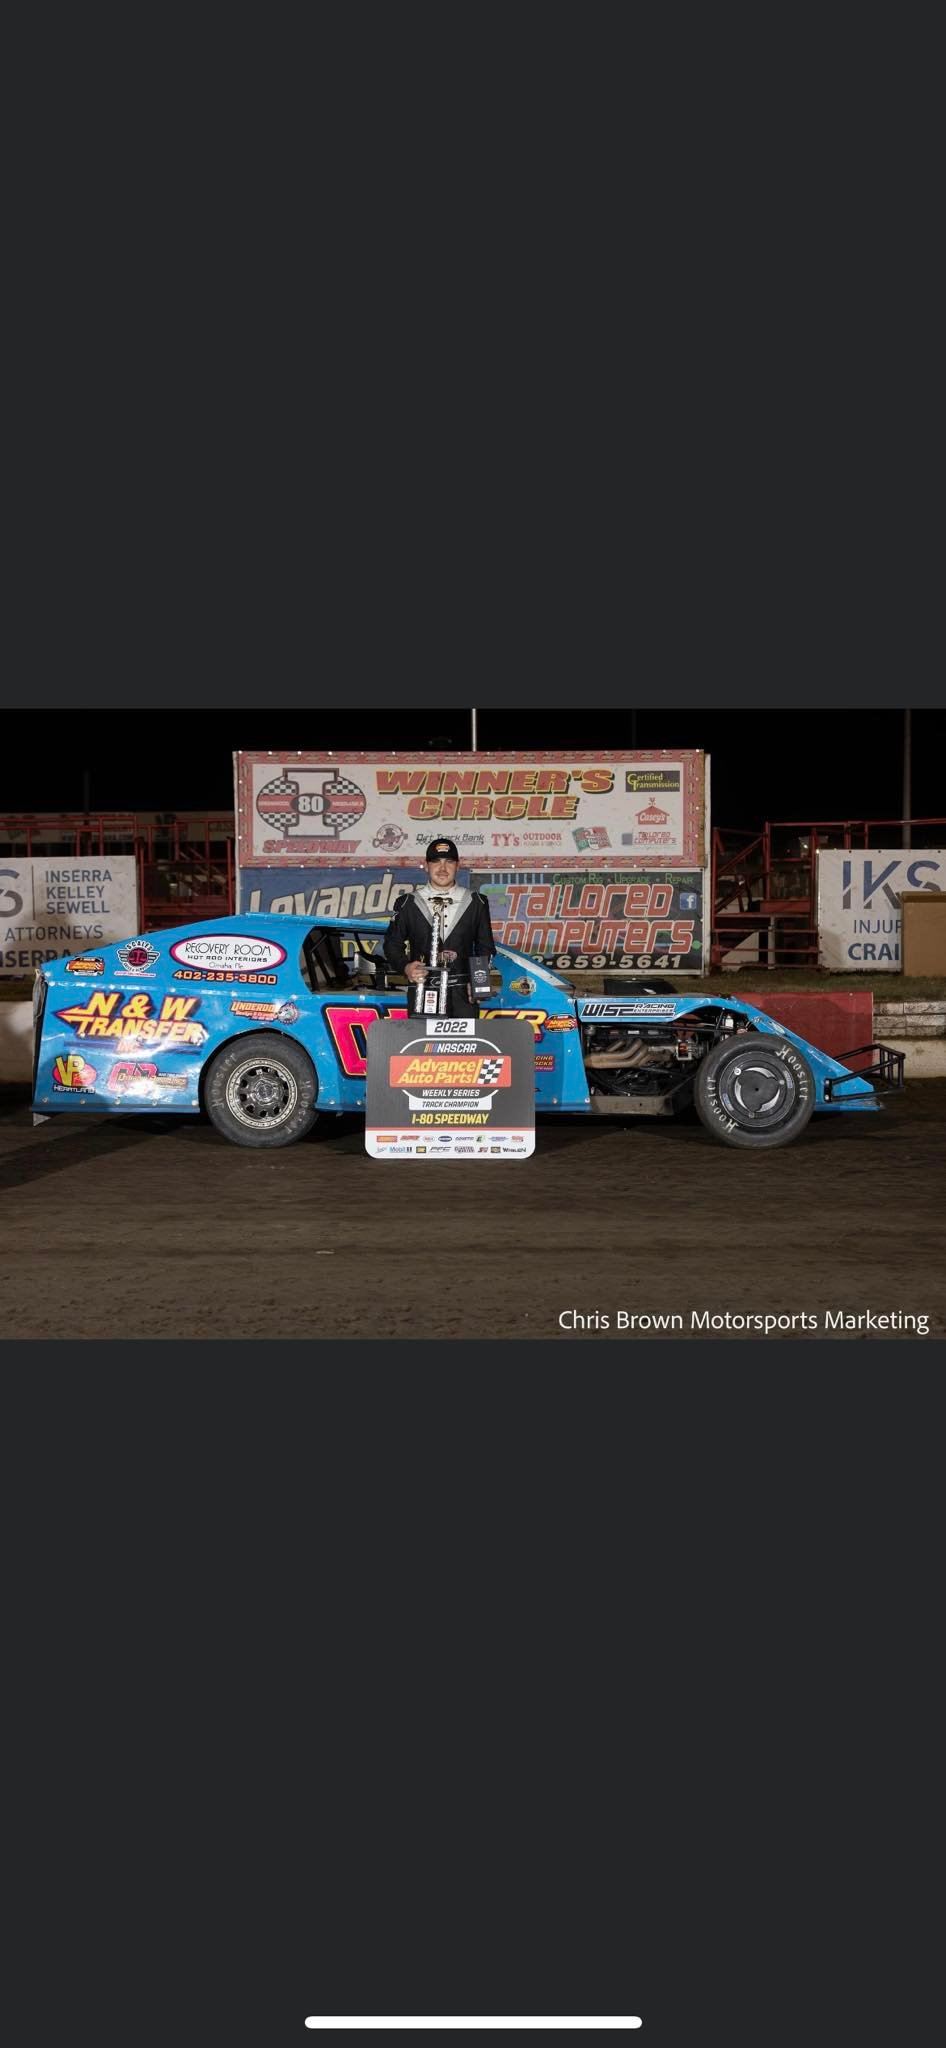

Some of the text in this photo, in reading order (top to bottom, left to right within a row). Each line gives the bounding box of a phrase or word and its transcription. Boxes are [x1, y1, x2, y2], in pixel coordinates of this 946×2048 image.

[376, 770, 615, 794] WINNER'S
[627, 772, 664, 785] Certified
[633, 780, 680, 791] Transmission
[298, 796, 324, 813] 80
[407, 796, 580, 820] CIRCLE
[263, 840, 362, 853] SPEEDWAY
[45, 870, 112, 882] INSERRA
[46, 886, 105, 899] KELLEY
[46, 901, 110, 914] SEWELL
[5, 925, 104, 941] ATTORNEYS
[185, 943, 272, 956] RECOVERY ROOM
[174, 970, 277, 984] 402-235-3800
[90, 993, 197, 1021] N & W
[73, 1017, 208, 1044] TRANSFER
[434, 1022, 468, 1033] 2022
[437, 1043, 477, 1053] NASCAR
[406, 1058, 477, 1073] Advance
[398, 1073, 474, 1084] Auto Parts
[54, 1085, 97, 1093] HEARTLAND
[422, 1089, 480, 1097] WEEKLY SERIES
[411, 1114, 489, 1125] I-80 SPEEDWAY
